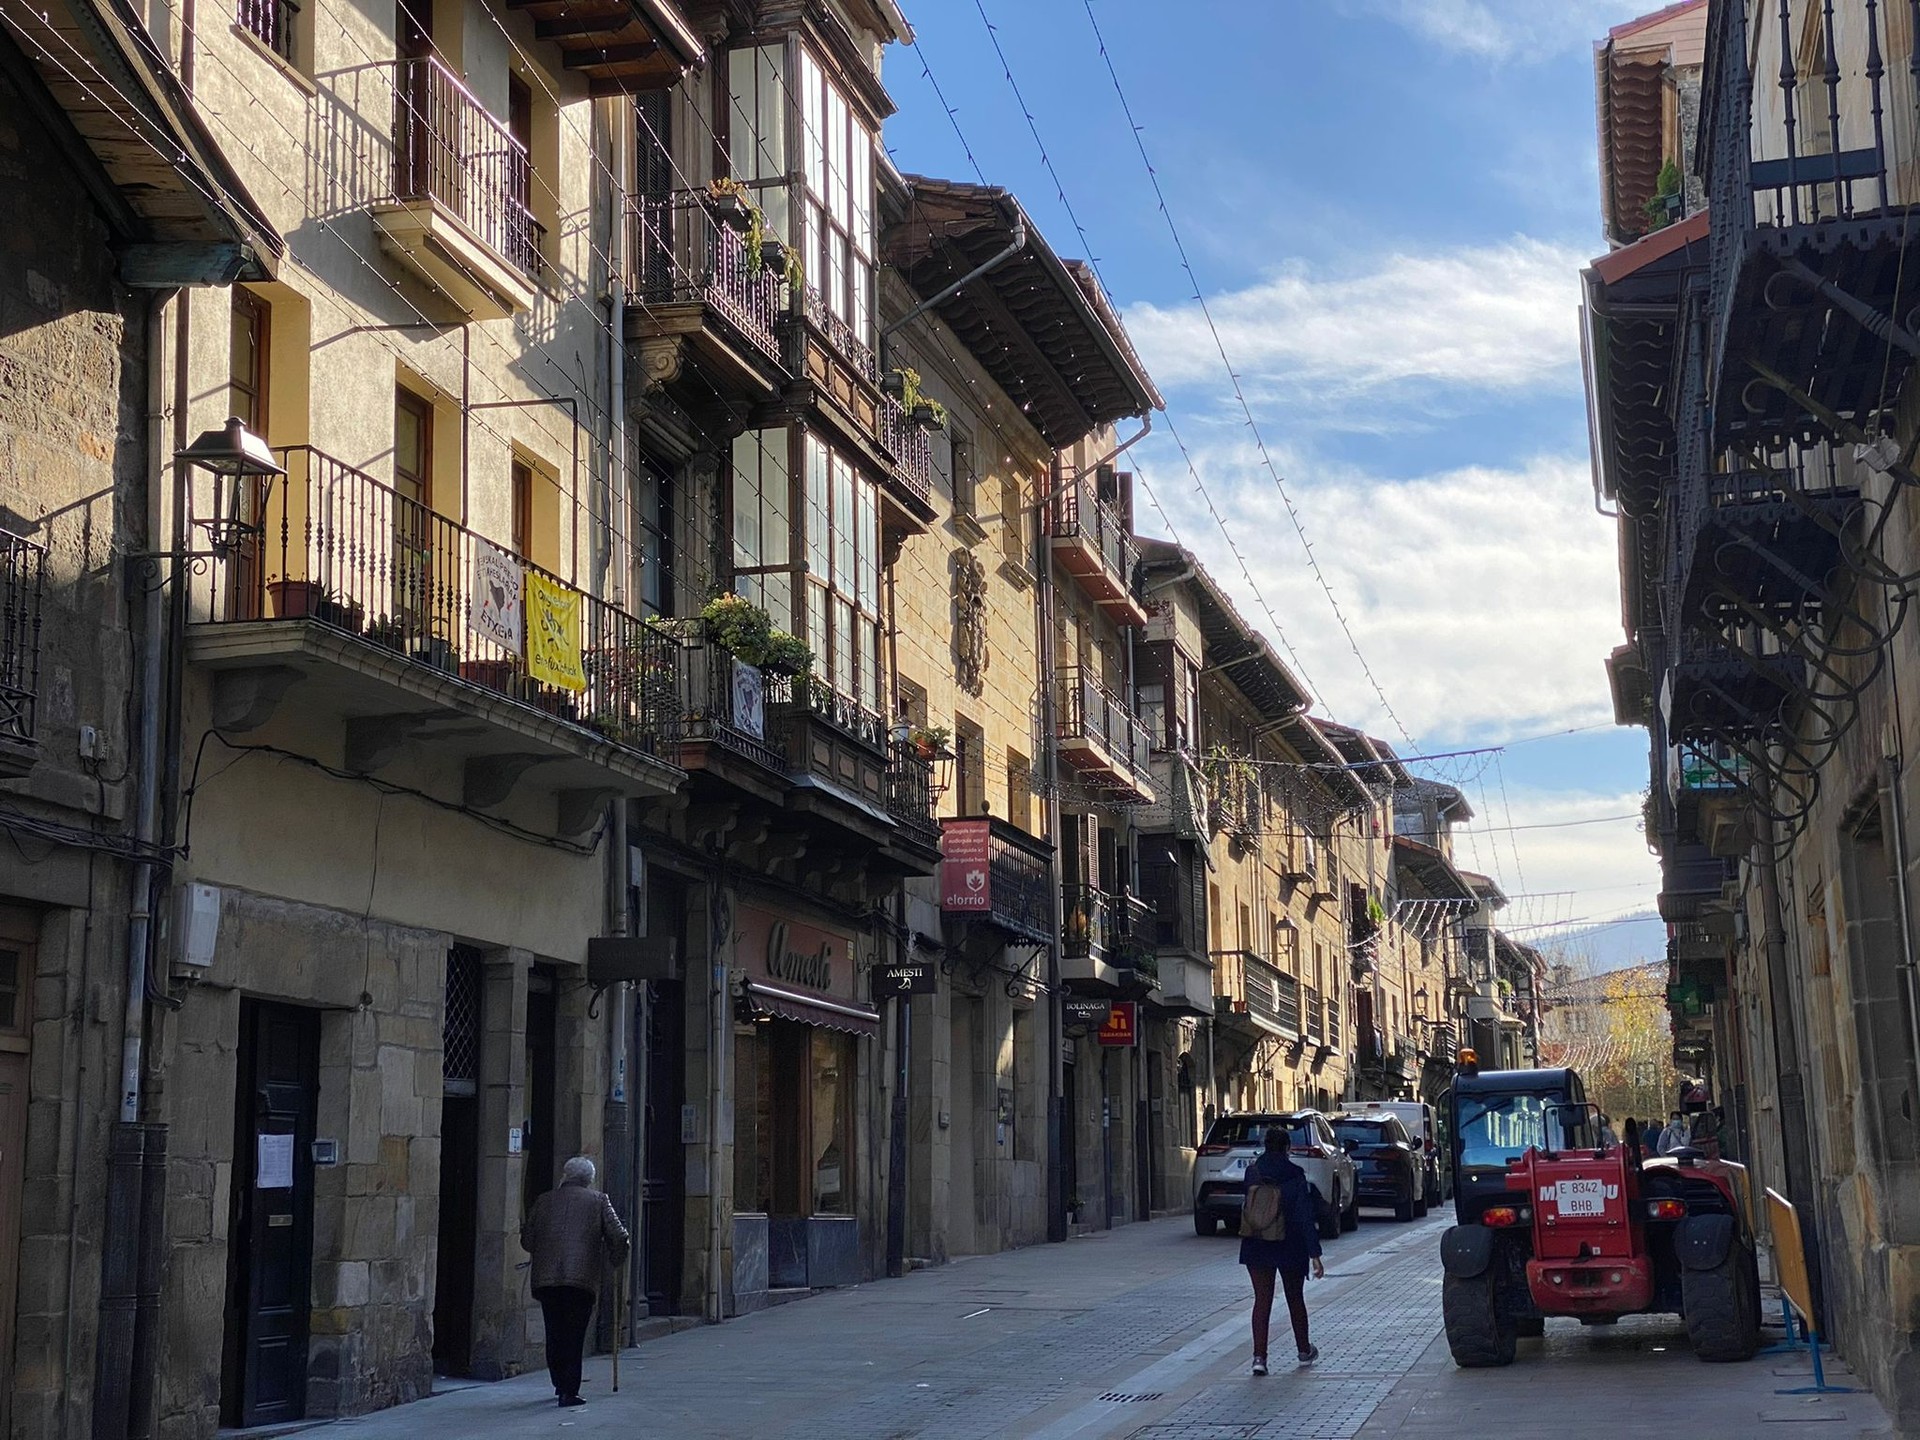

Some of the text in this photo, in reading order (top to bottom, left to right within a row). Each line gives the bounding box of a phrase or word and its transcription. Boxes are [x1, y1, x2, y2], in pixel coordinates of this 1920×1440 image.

[947, 894, 984, 904] elorrio
[887, 968, 923, 978] AMESTI
[1560, 1183, 1566, 1194] E
[1572, 1182, 1597, 1193] 8342
[1571, 1200, 1592, 1211] BHB
